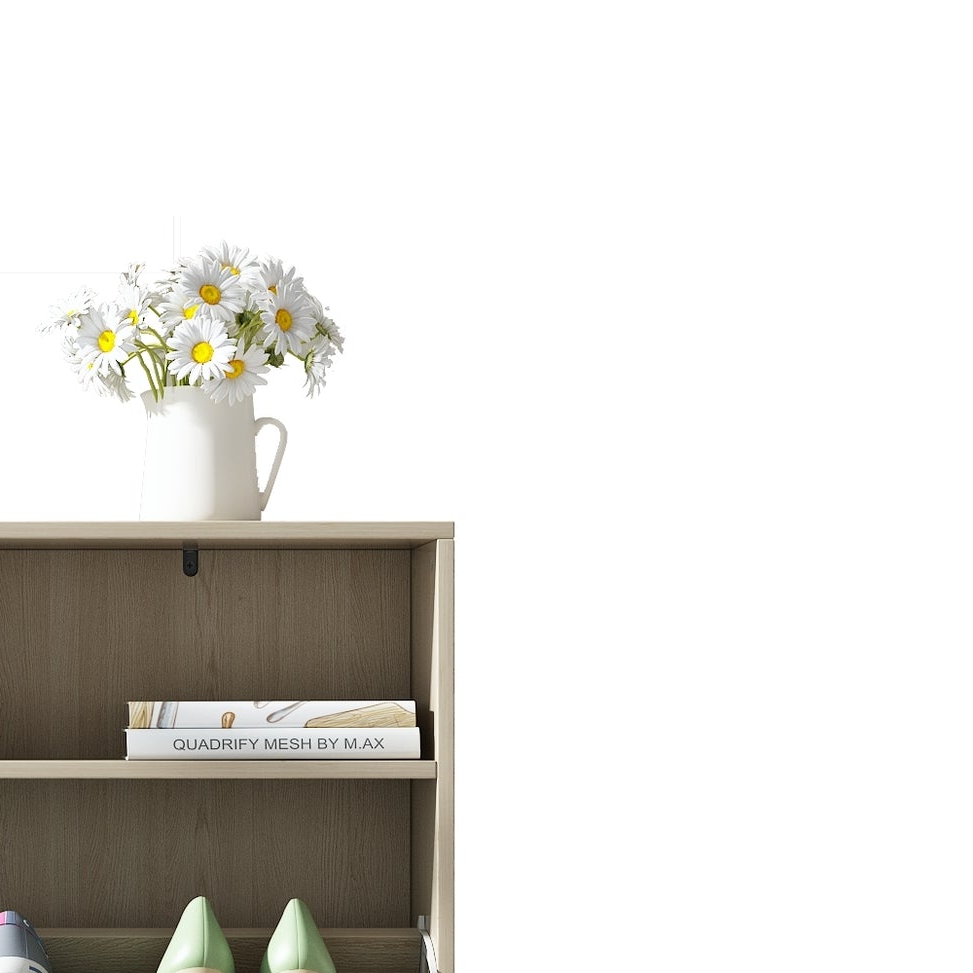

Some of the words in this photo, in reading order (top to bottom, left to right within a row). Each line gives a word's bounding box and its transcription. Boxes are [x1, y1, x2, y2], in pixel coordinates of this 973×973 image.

[173, 738, 259, 751] QUADRIFY
[264, 738, 312, 750] MESH
[317, 738, 339, 750] BY
[344, 738, 385, 750] M.AX
